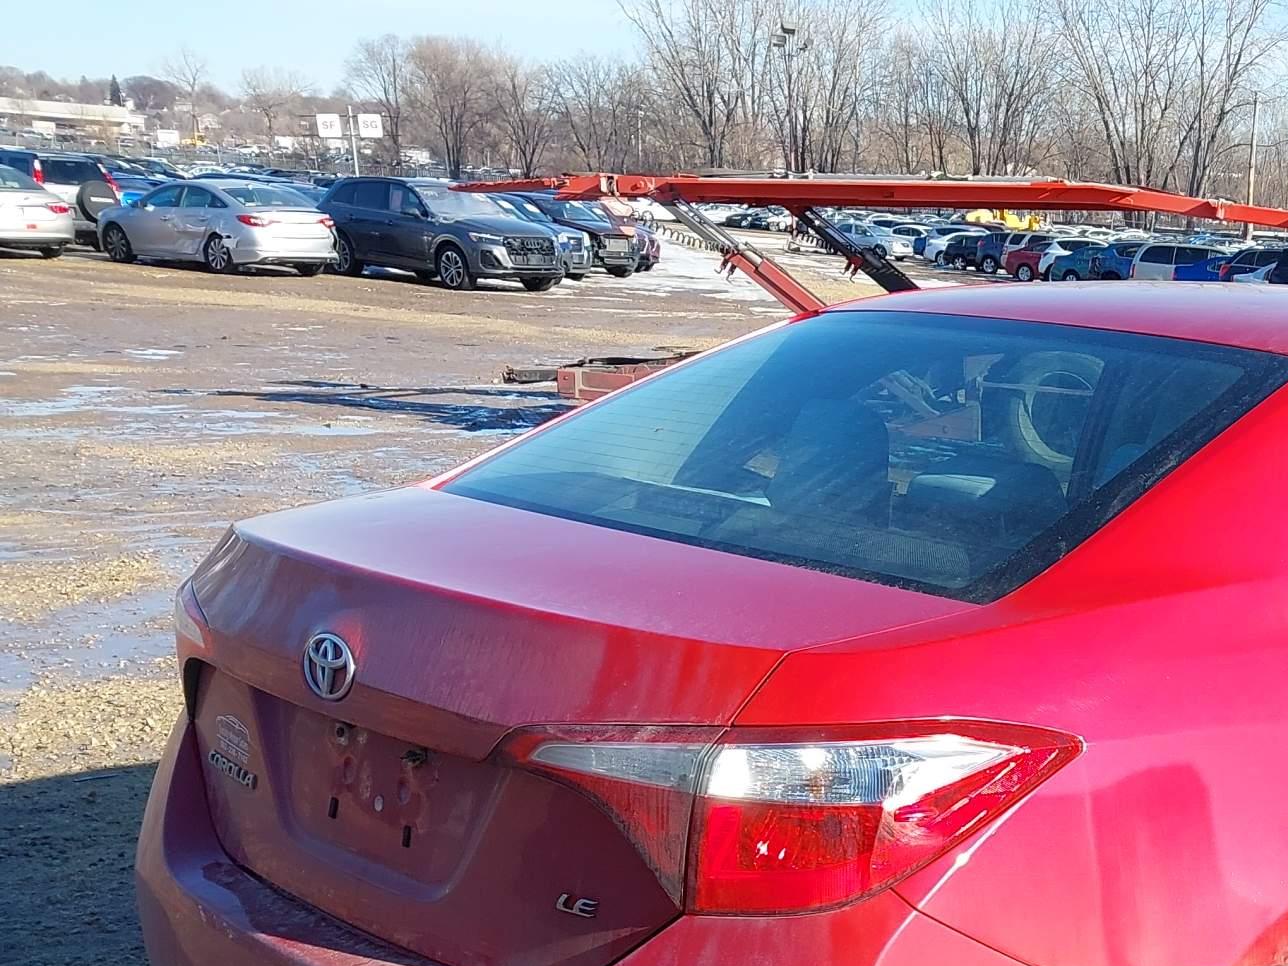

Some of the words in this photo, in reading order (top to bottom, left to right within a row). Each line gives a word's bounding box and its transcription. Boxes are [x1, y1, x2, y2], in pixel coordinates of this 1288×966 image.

[321, 121, 335, 129] SF
[362, 120, 378, 129] SG
[208, 751, 256, 789] COROLLA
[556, 893, 599, 917] LE
